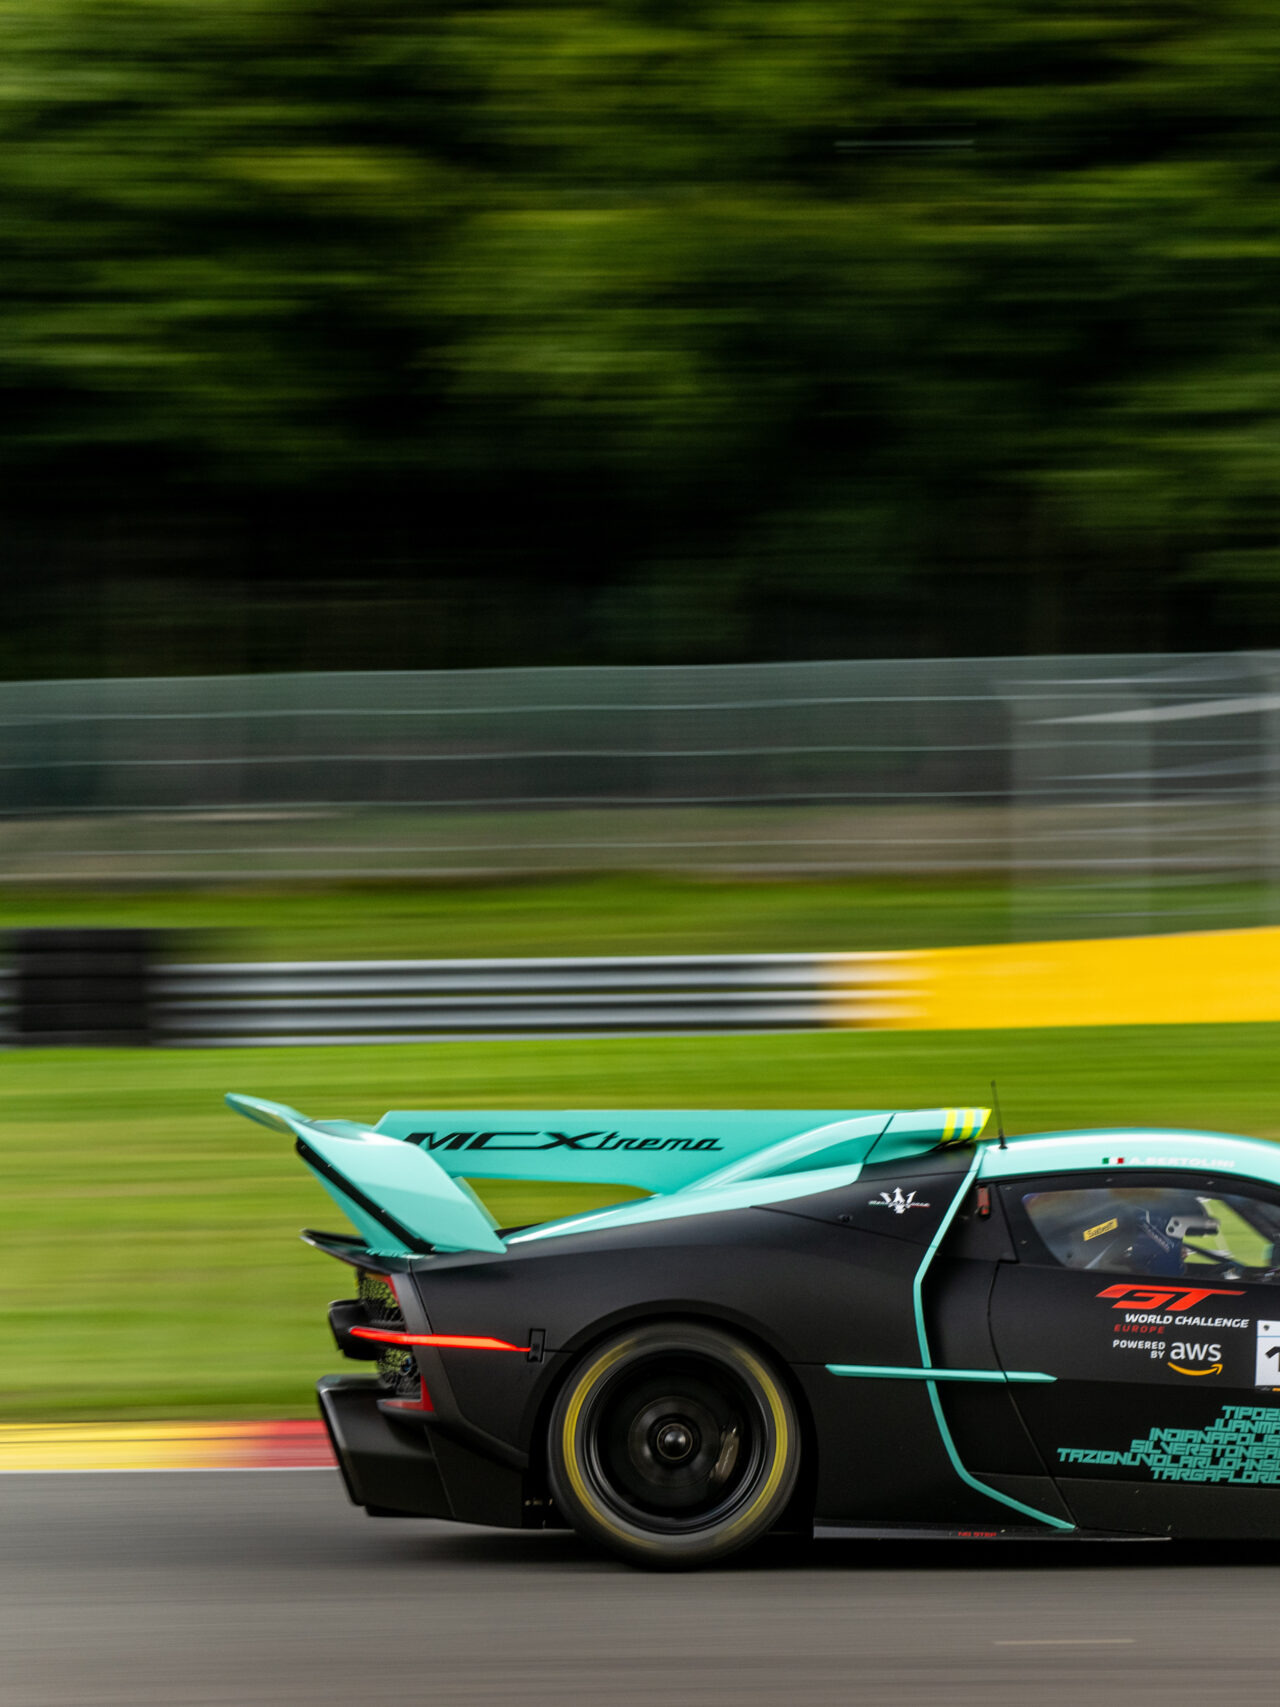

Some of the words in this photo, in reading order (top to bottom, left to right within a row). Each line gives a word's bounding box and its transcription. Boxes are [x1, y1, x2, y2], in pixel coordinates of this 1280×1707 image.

[1095, 1283, 1248, 1311] GT
[1125, 1313, 1173, 1325] WORLD
[1174, 1316, 1250, 1328] CHALLENGE
[1113, 1324, 1166, 1334] EUROPE
[1112, 1339, 1166, 1350] POWERED
[1150, 1350, 1166, 1359] BY
[1170, 1342, 1222, 1362] aws
